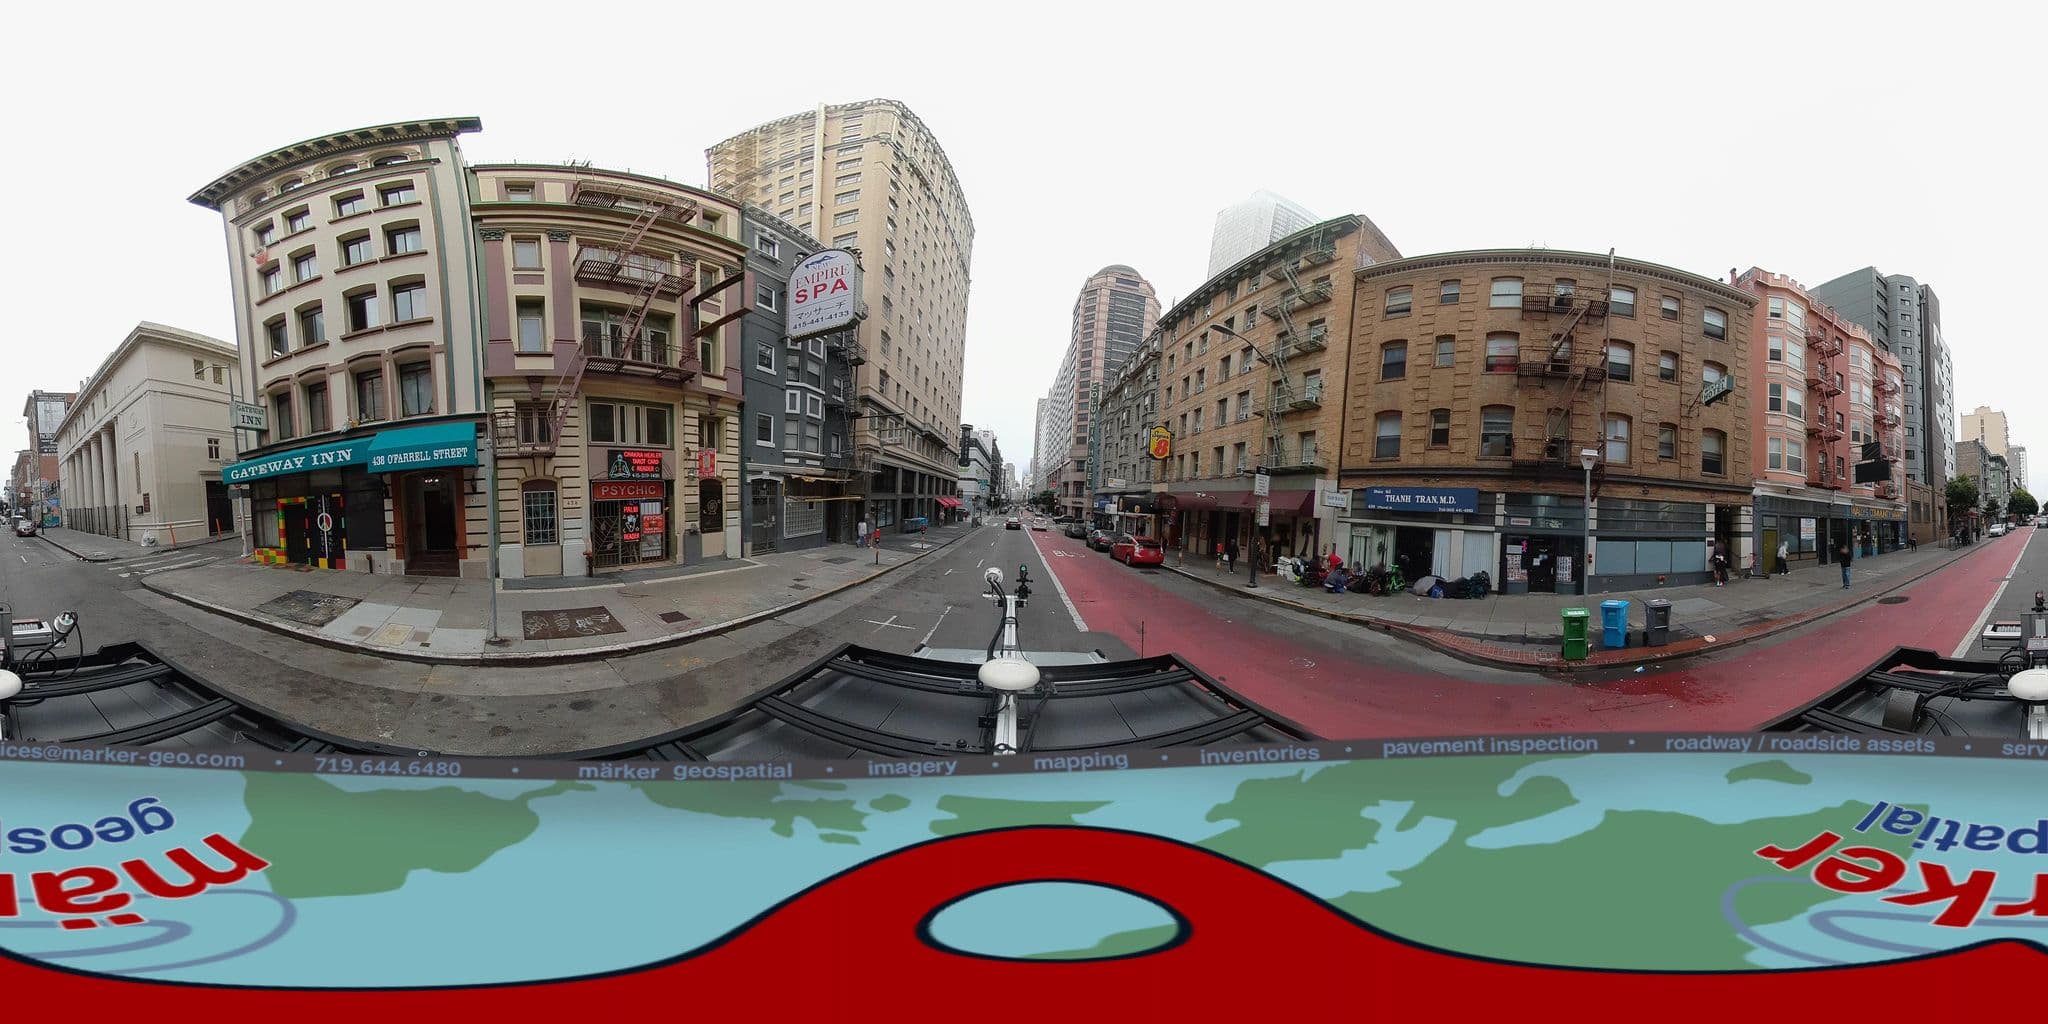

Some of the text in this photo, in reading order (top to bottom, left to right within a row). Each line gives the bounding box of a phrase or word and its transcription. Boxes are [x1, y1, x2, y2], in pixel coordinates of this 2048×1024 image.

[795, 263, 851, 289] EMPIRE
[795, 278, 849, 304] SPA
[792, 310, 850, 330] 415-441-4133
[240, 414, 262, 426] INN
[372, 447, 468, 466] 438 O'FARRELL STREET
[1154, 439, 1169, 456] 8
[230, 448, 353, 480] GATEWAY INN
[1085, 448, 1094, 488] HOTEL
[601, 485, 656, 496] PSYCHIC
[1385, 494, 1457, 505] THANH TRAN, M.D.
